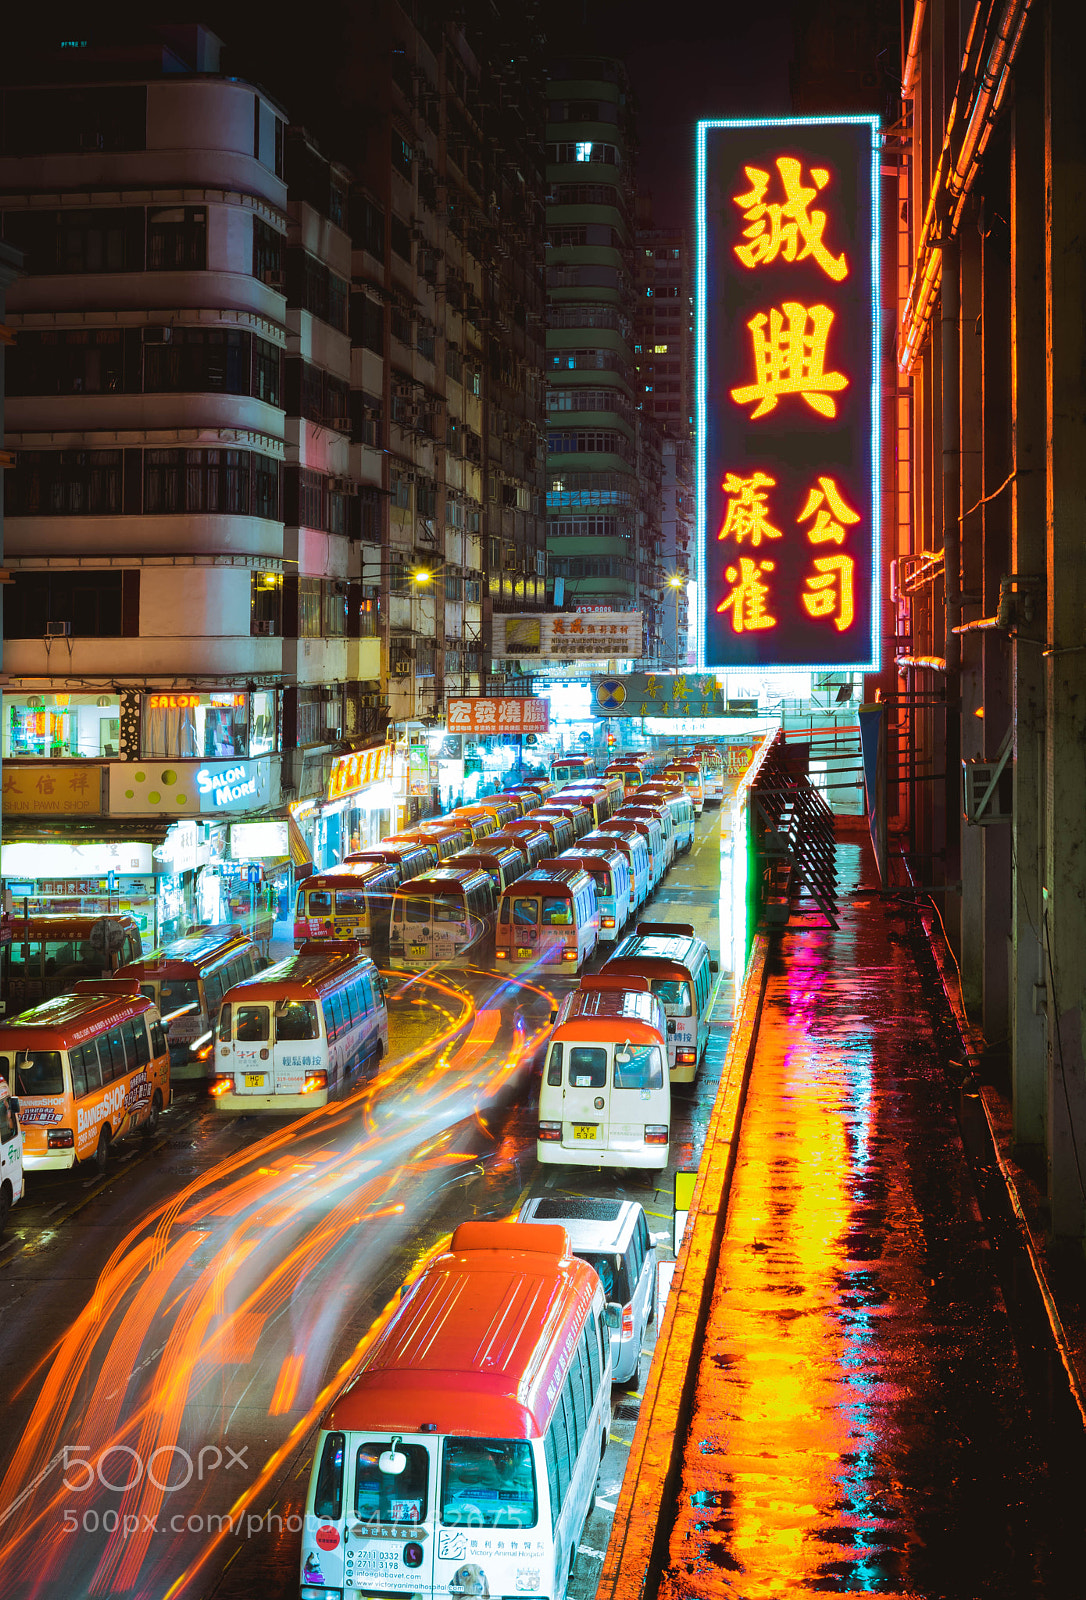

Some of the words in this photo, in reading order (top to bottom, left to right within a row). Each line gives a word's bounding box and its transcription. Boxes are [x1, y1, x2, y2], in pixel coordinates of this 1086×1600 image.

[730, 156, 850, 420] 誠興
[796, 476, 861, 632] 公司
[506, 643, 539, 653] Nikon
[150, 695, 200, 708] SALON
[196, 765, 246, 793] SALON
[214, 775, 256, 806] MORE
[3, 800, 30, 811] SHUN
[33, 800, 60, 810] PAWN
[63, 800, 90, 810] SHOP
[357, 1550, 377, 1559] 2711
[379, 1551, 399, 1560] 0332
[470, 1549, 493, 1558] Victory
[494, 1550, 518, 1558] Animal
[357, 1560, 377, 1569] 2711
[379, 1561, 399, 1570] 3198
